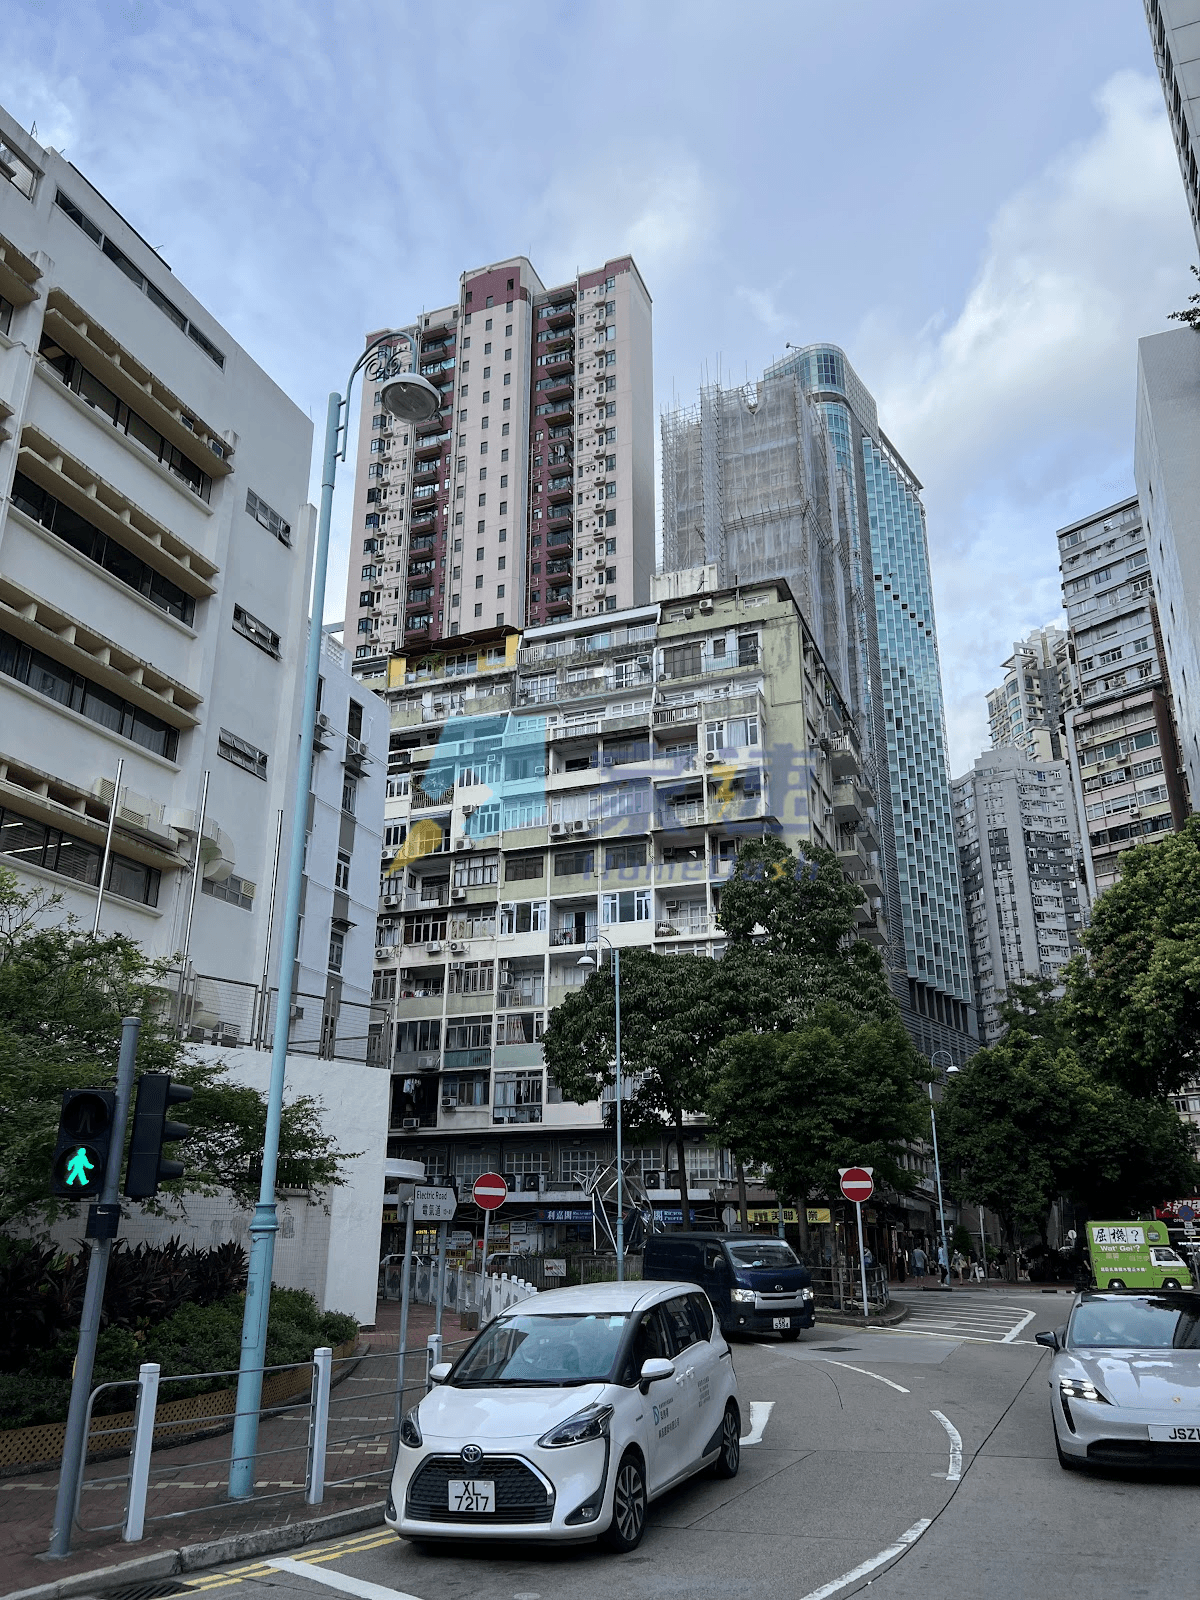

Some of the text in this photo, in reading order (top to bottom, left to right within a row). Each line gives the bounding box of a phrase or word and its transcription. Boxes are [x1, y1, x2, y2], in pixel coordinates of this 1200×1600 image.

[416, 1190, 448, 1200] Electric Road
[422, 1203, 441, 1217] 電氣道
[547, 1210, 572, 1220] 利嘉閣
[771, 1210, 818, 1221] 美聯業
[463, 1481, 481, 1496] XL
[454, 1496, 489, 1511] 7217
